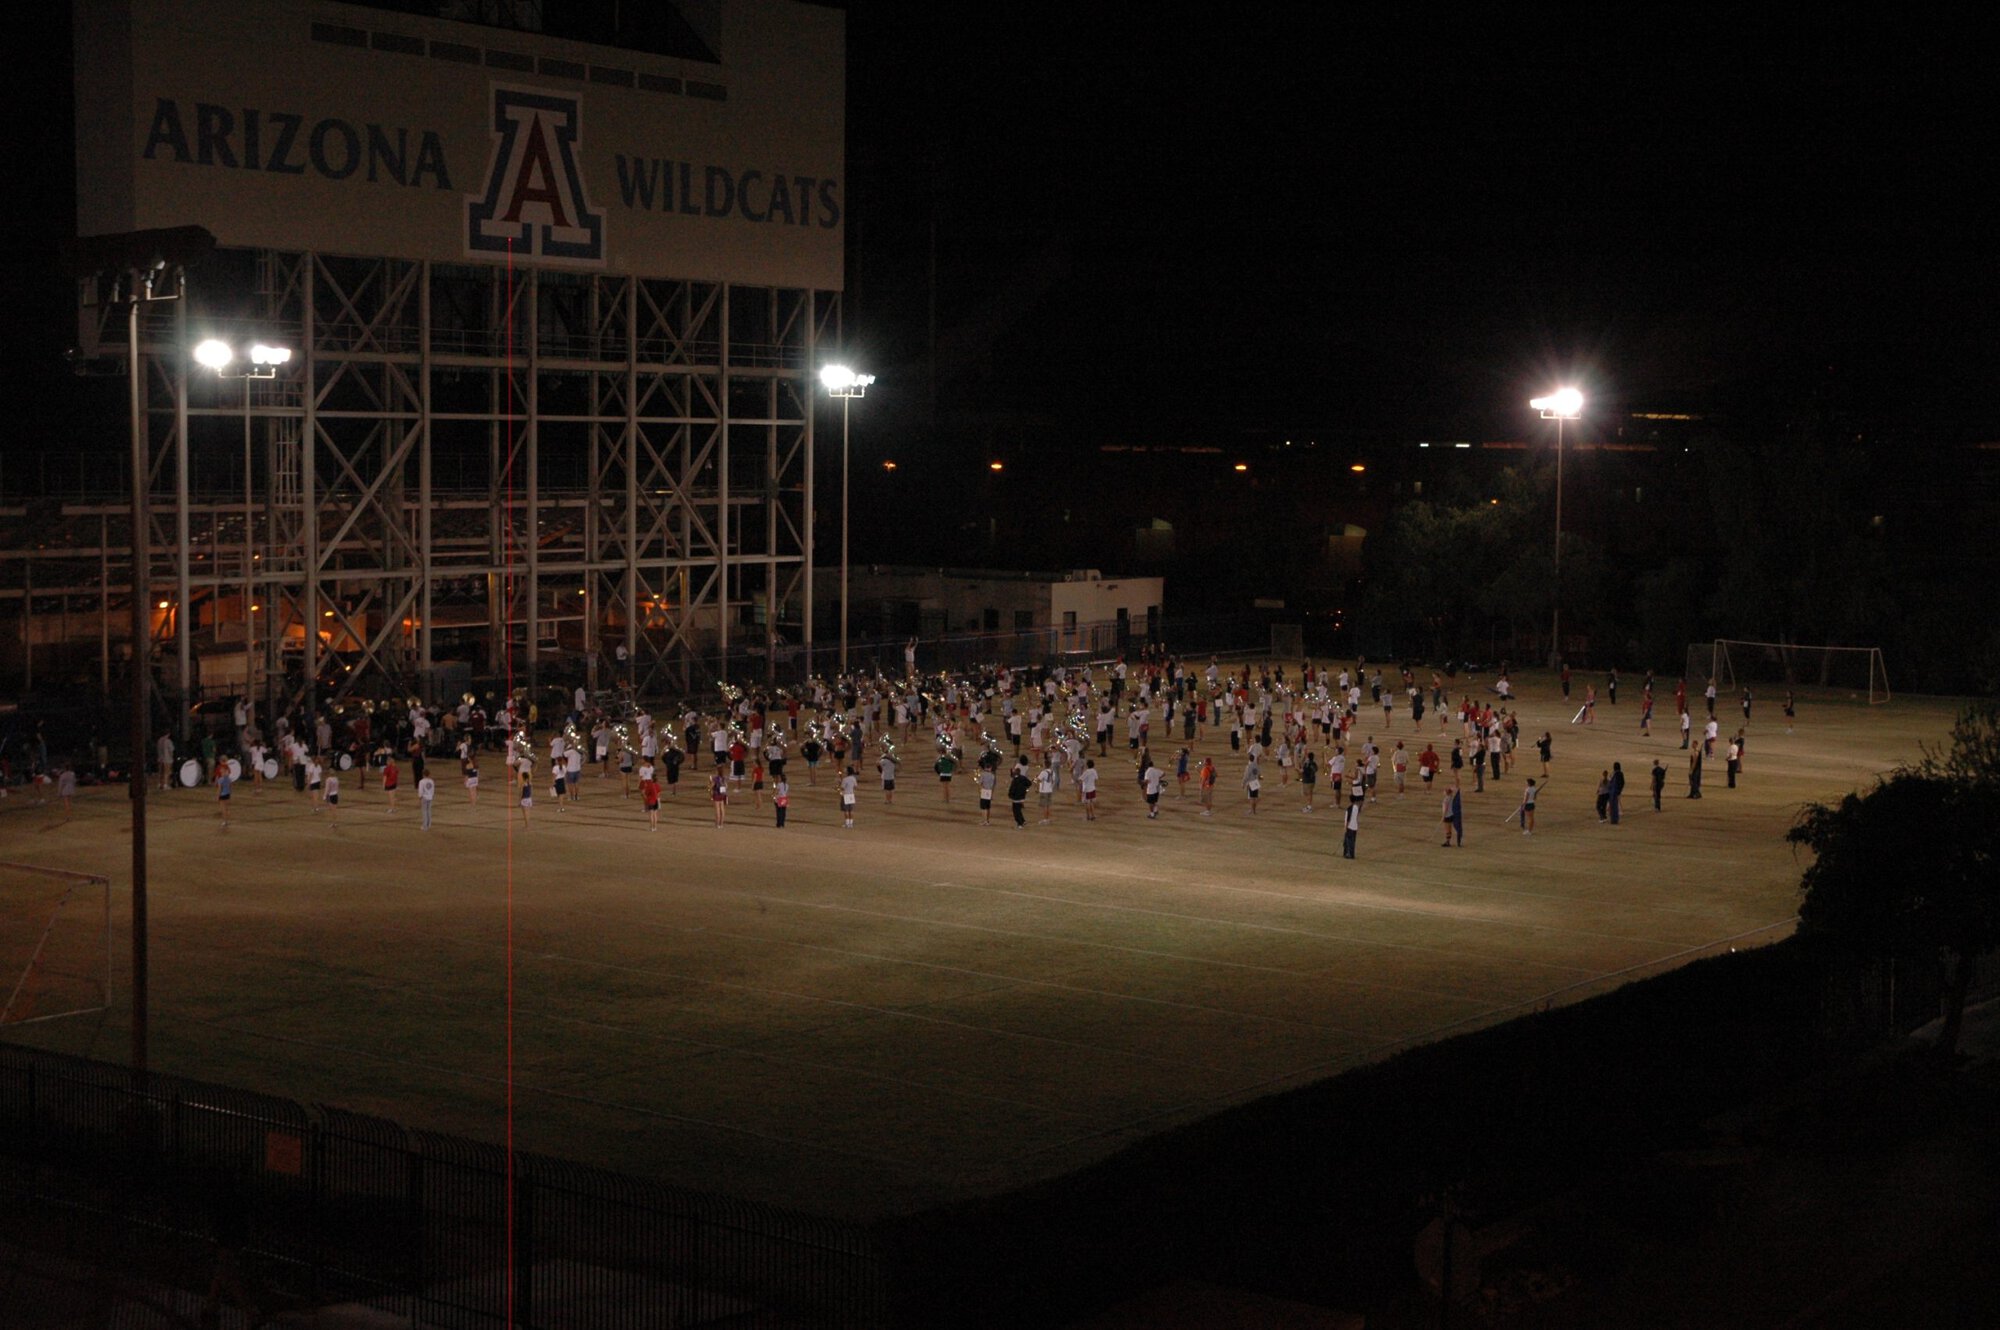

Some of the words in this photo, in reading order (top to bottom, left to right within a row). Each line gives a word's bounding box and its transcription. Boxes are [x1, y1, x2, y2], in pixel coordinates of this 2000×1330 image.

[144, 99, 451, 190] ARIZONA
[467, 86, 603, 262] A
[617, 154, 840, 229] WILDCATS
